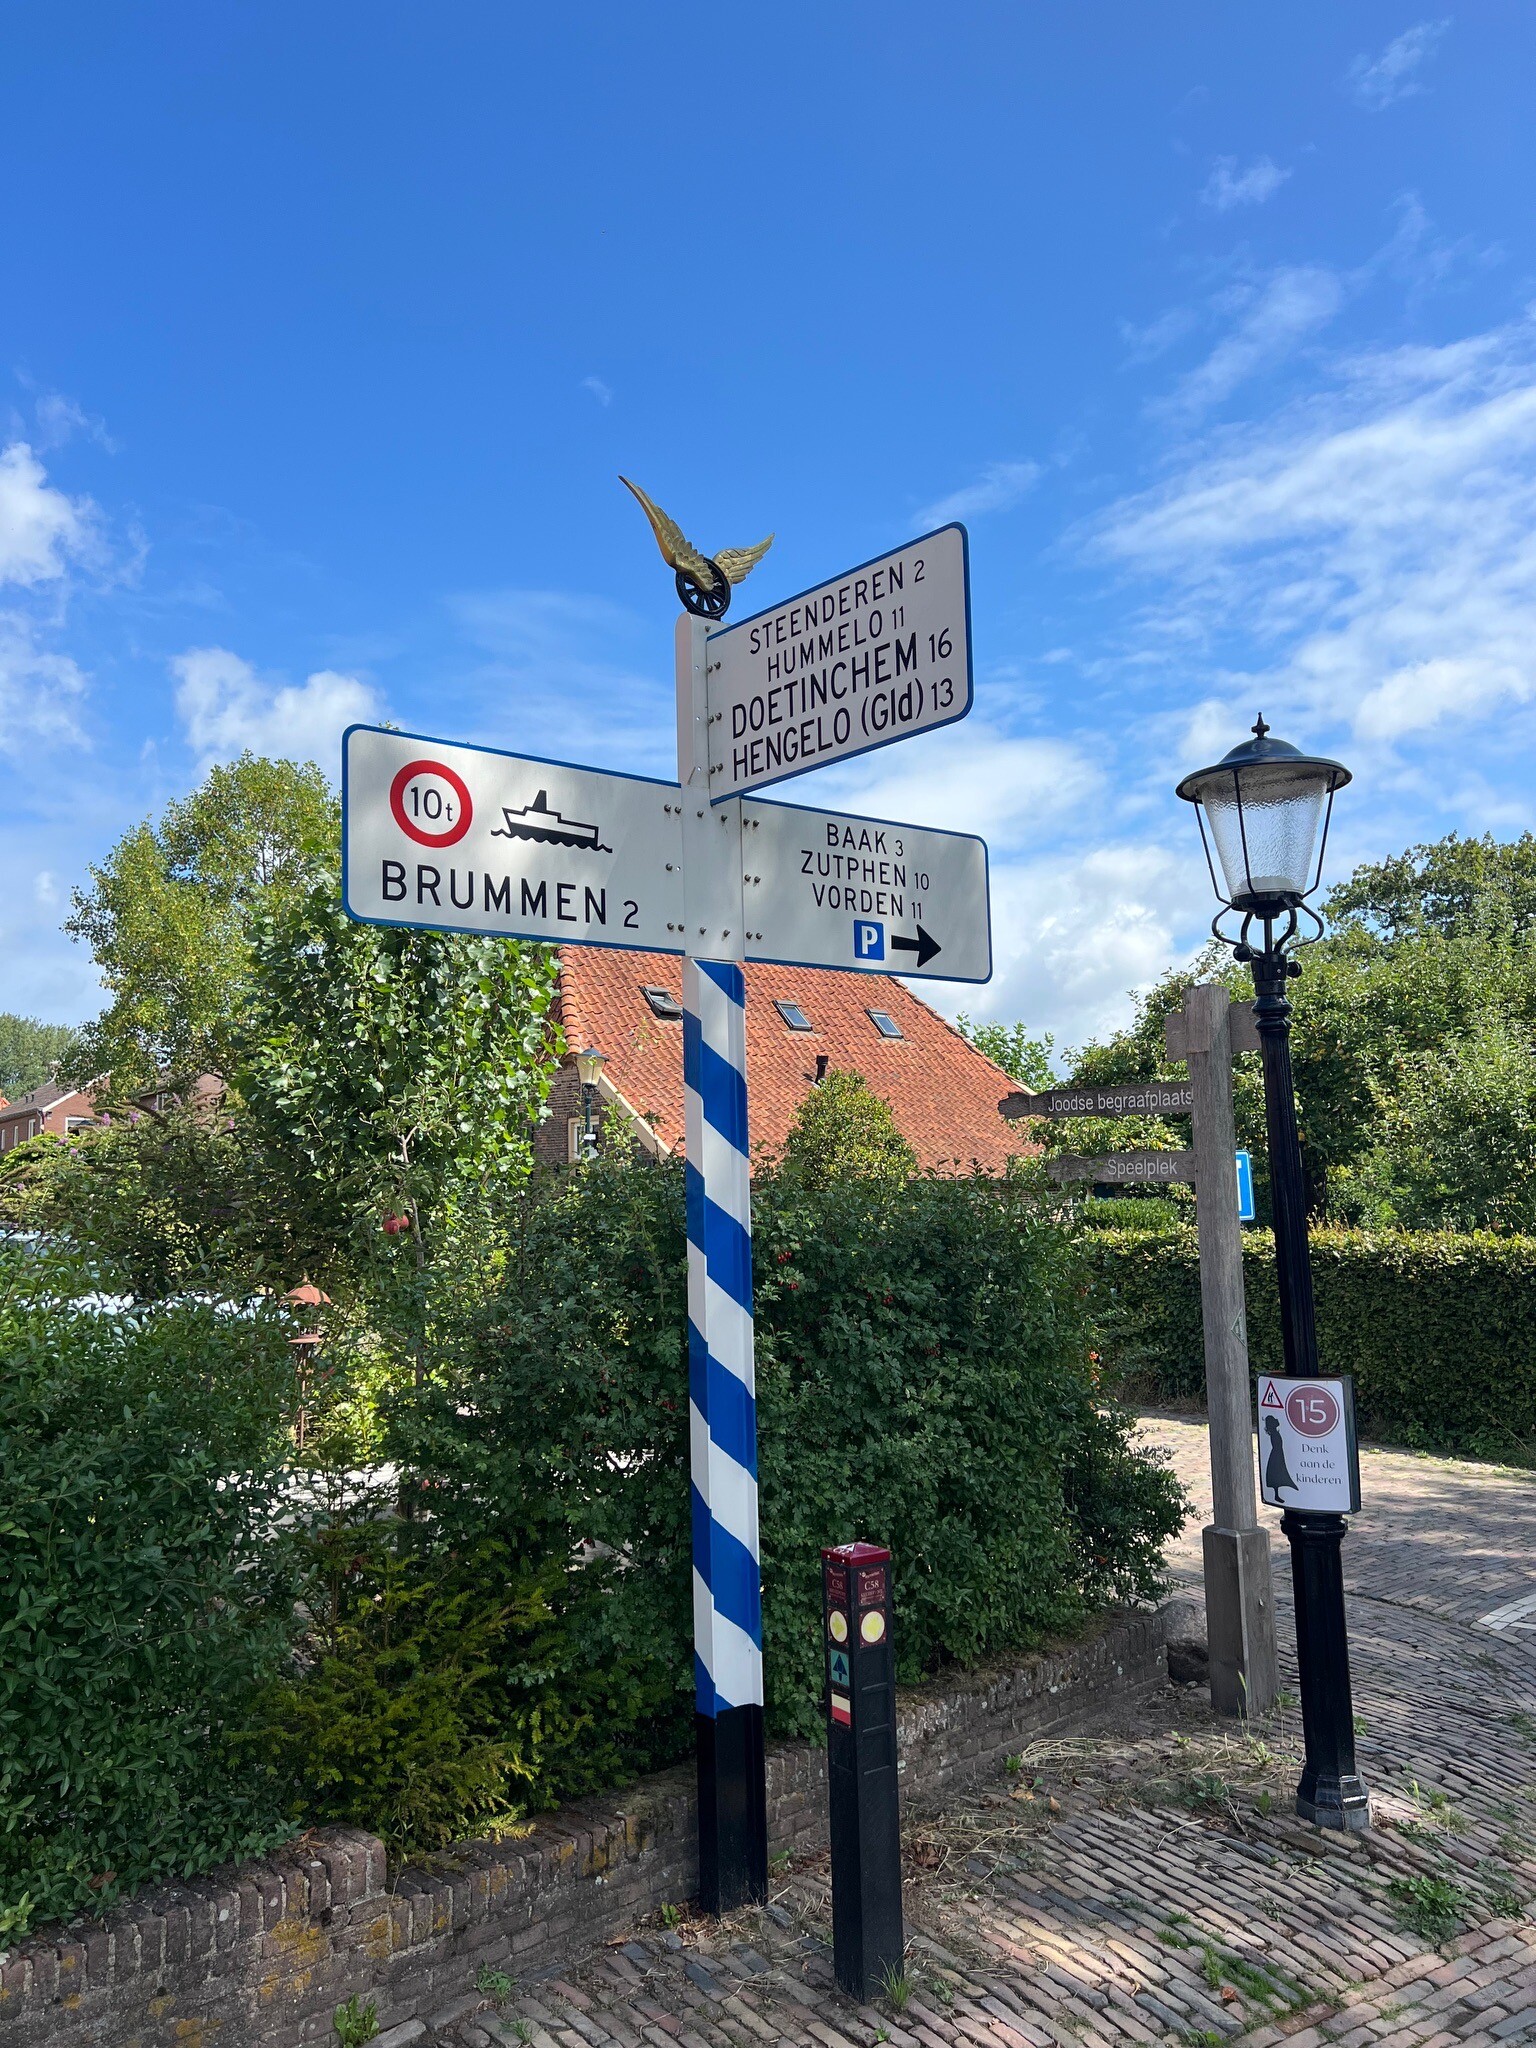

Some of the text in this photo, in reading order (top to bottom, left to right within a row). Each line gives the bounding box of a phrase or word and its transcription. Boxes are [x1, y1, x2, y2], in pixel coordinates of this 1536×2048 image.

[750, 559, 925, 654] STEENDEREN 2
[768, 605, 904, 682] HUMMELO 11
[732, 627, 952, 739] DOETINCHEM 16
[733, 678, 953, 781] HENGELO (Gld) 13
[827, 823, 903, 856] BAAK 3
[801, 850, 929, 890] ZUTPHEN 10
[382, 860, 639, 928] BRUMMEN 2
[812, 883, 922, 919] VORDEN 11
[861, 926, 878, 954] P
[1048, 1089, 1192, 1113] Joodse begraafplaats
[1107, 1158, 1178, 1178] Speelplek
[1295, 1399, 1327, 1424] 15
[1301, 1444, 1329, 1453] Denk
[1296, 1473, 1341, 1485] kinderen
[1300, 1460, 1335, 1469] aan de
[864, 1580, 879, 1590] C58
